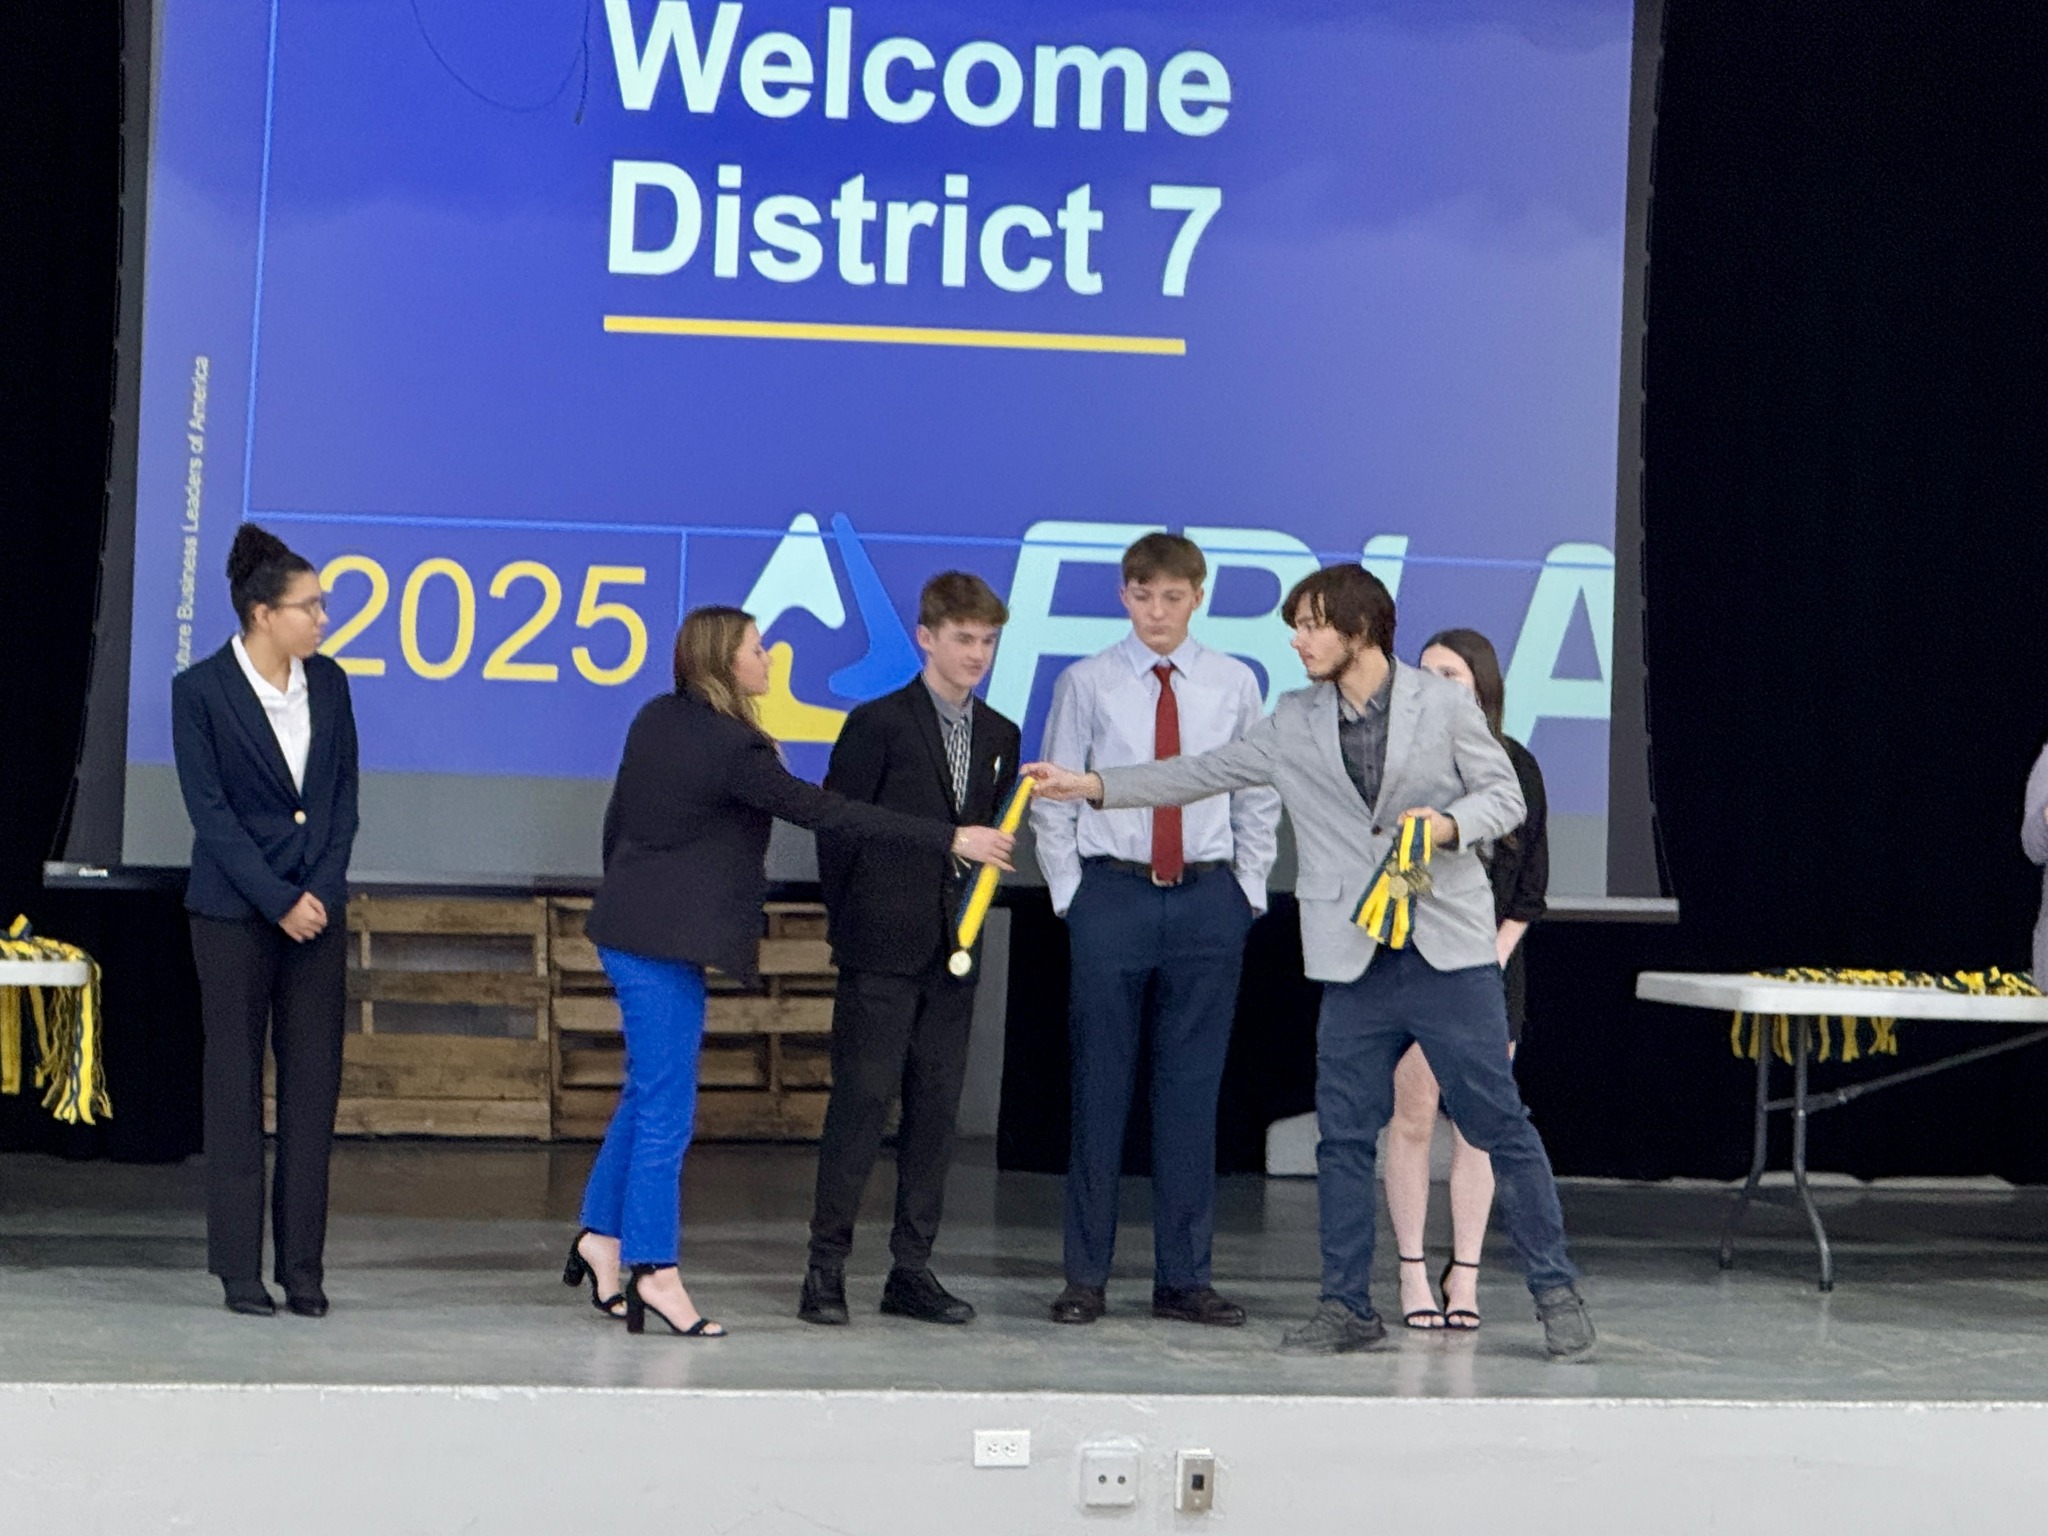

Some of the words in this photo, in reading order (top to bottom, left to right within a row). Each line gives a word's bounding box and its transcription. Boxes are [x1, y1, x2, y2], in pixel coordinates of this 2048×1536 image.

[604, 0, 1232, 136] Welcome
[608, 159, 1104, 295] District
[1150, 184, 1222, 297] 7
[188, 356, 209, 432] America
[187, 432, 204, 454] of
[181, 457, 203, 532] Leaders
[176, 535, 198, 620] Business
[172, 623, 192, 677] uture
[316, 554, 648, 686] 2025
